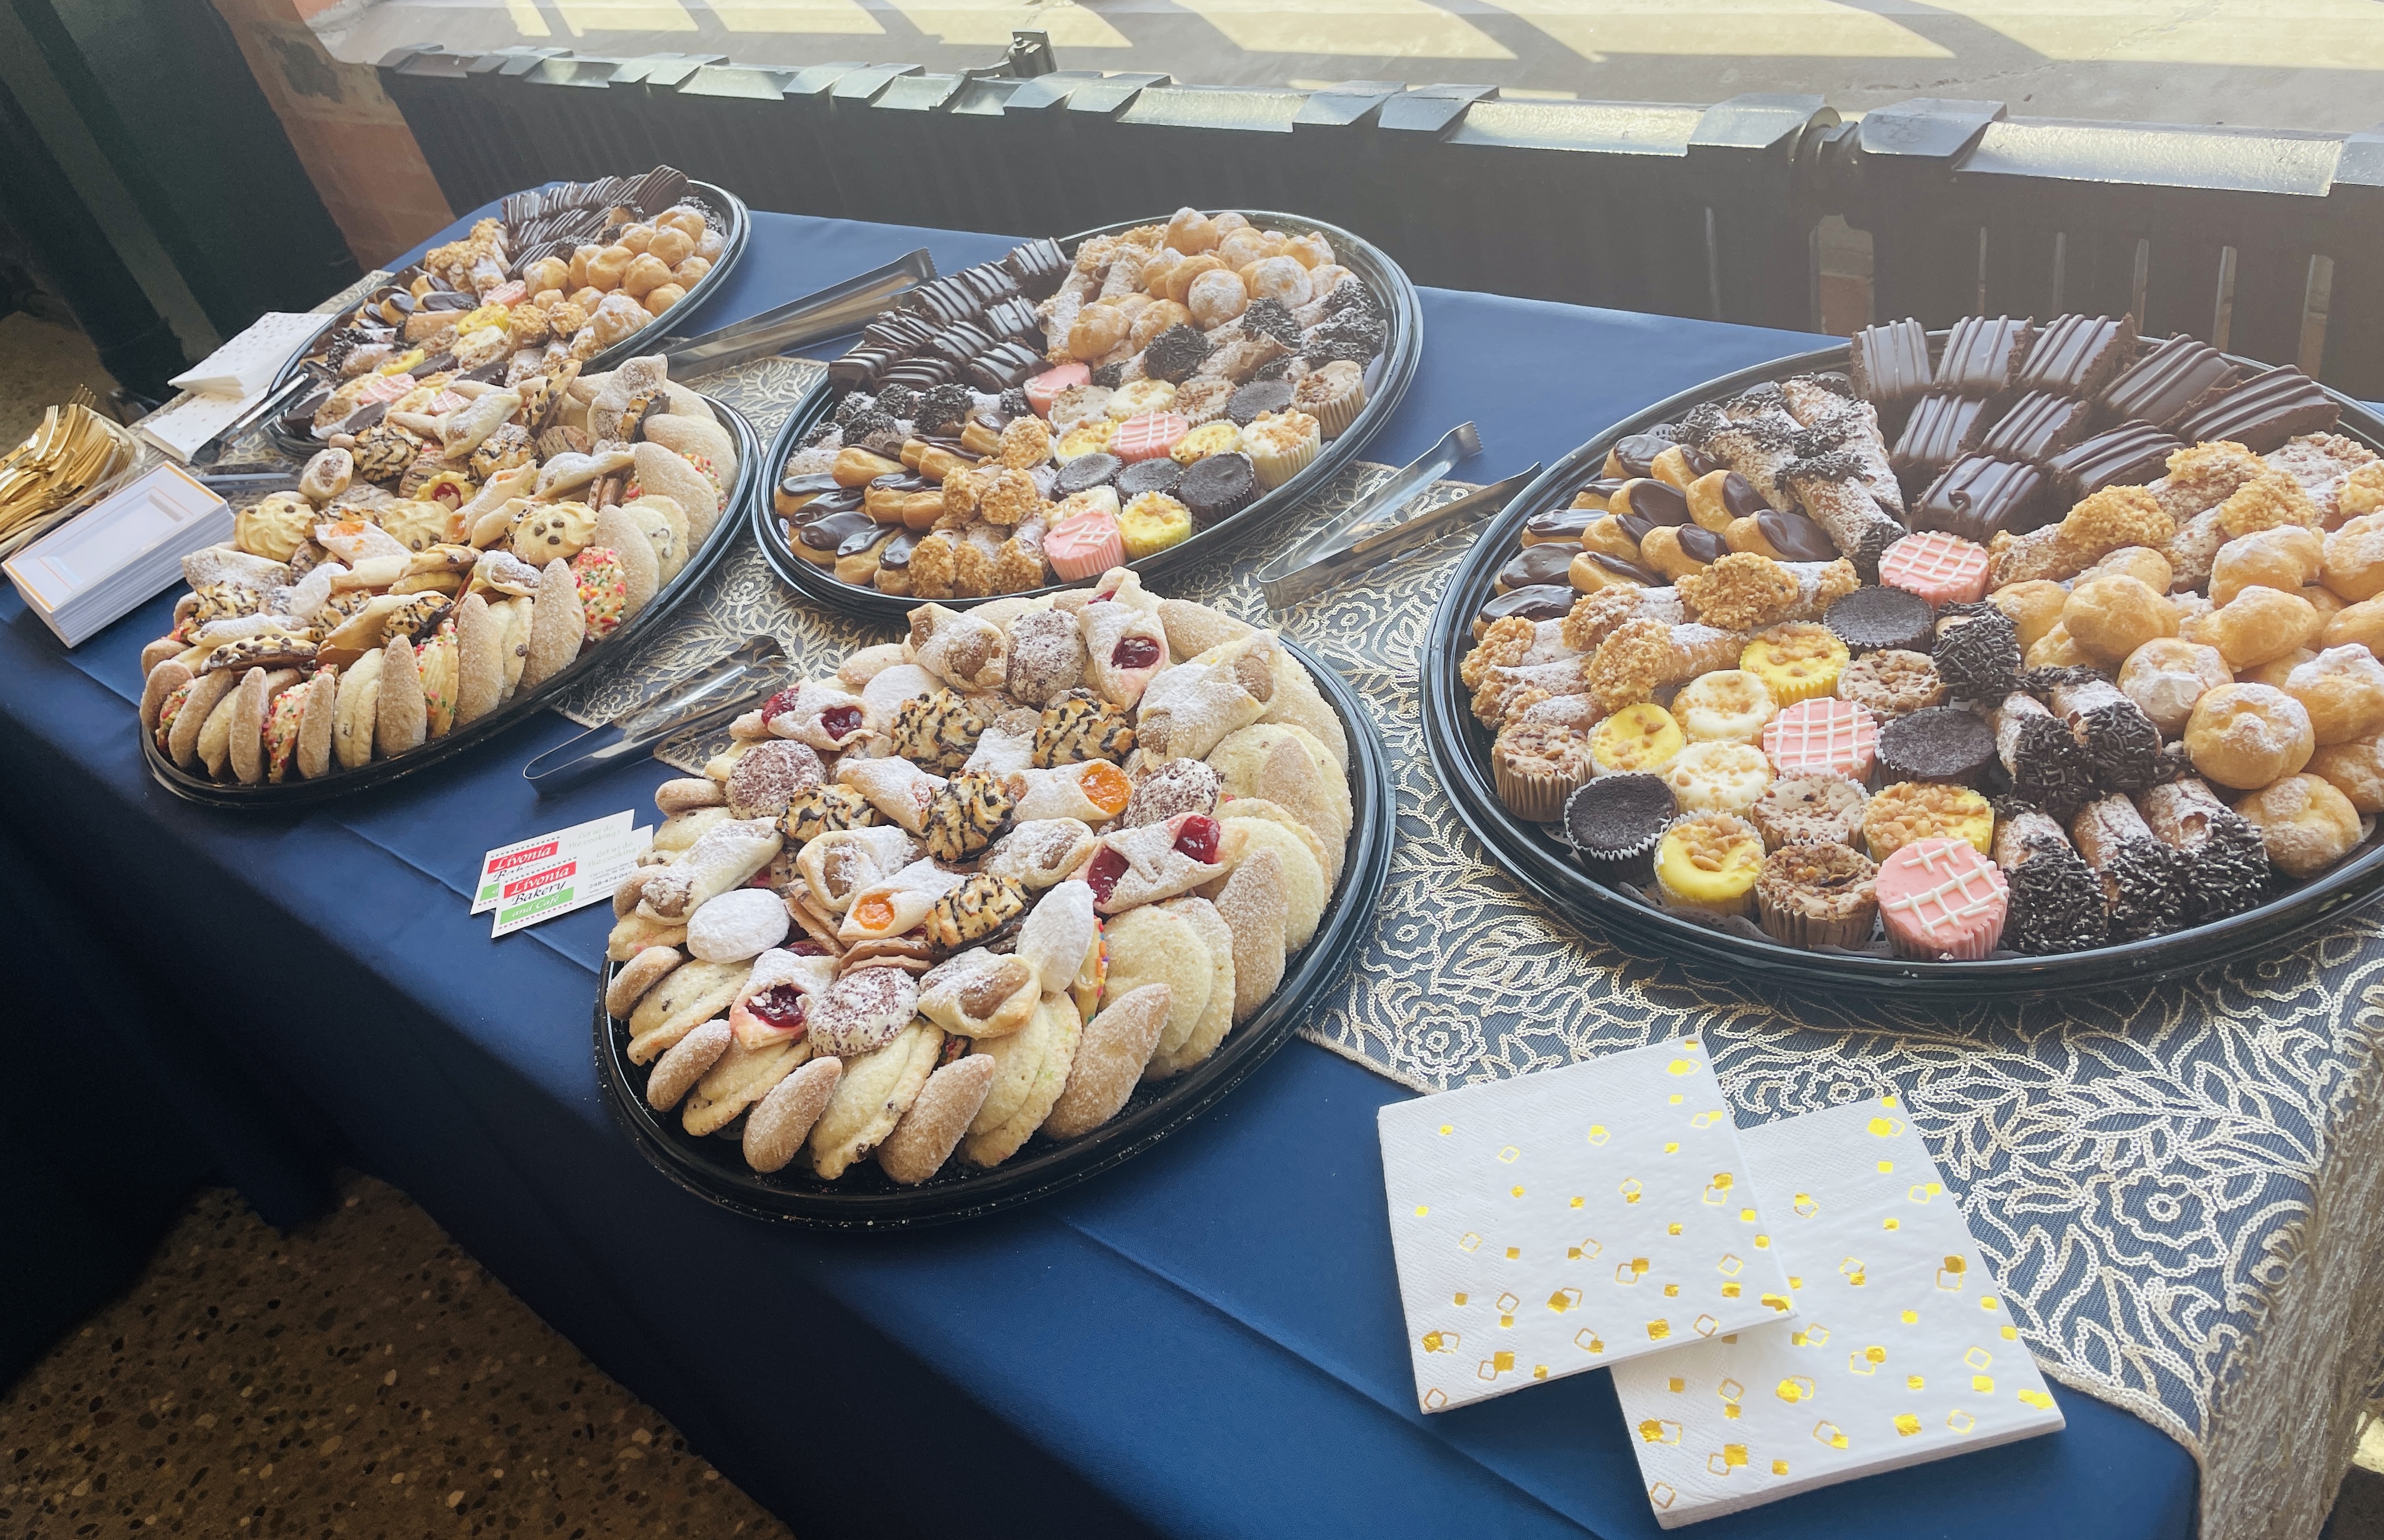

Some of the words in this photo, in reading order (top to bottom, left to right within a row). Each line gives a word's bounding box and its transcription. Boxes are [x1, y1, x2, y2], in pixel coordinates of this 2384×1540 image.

[578, 831, 591, 839] Let
[583, 831, 616, 845] cooking
[493, 846, 552, 871] Livonia
[588, 860, 601, 868] the
[603, 847, 636, 863] cooking
[597, 848, 609, 858] Let
[510, 867, 569, 895] Livonia
[511, 880, 566, 906] Bakery
[512, 902, 536, 917] and
[536, 893, 560, 909] Café
